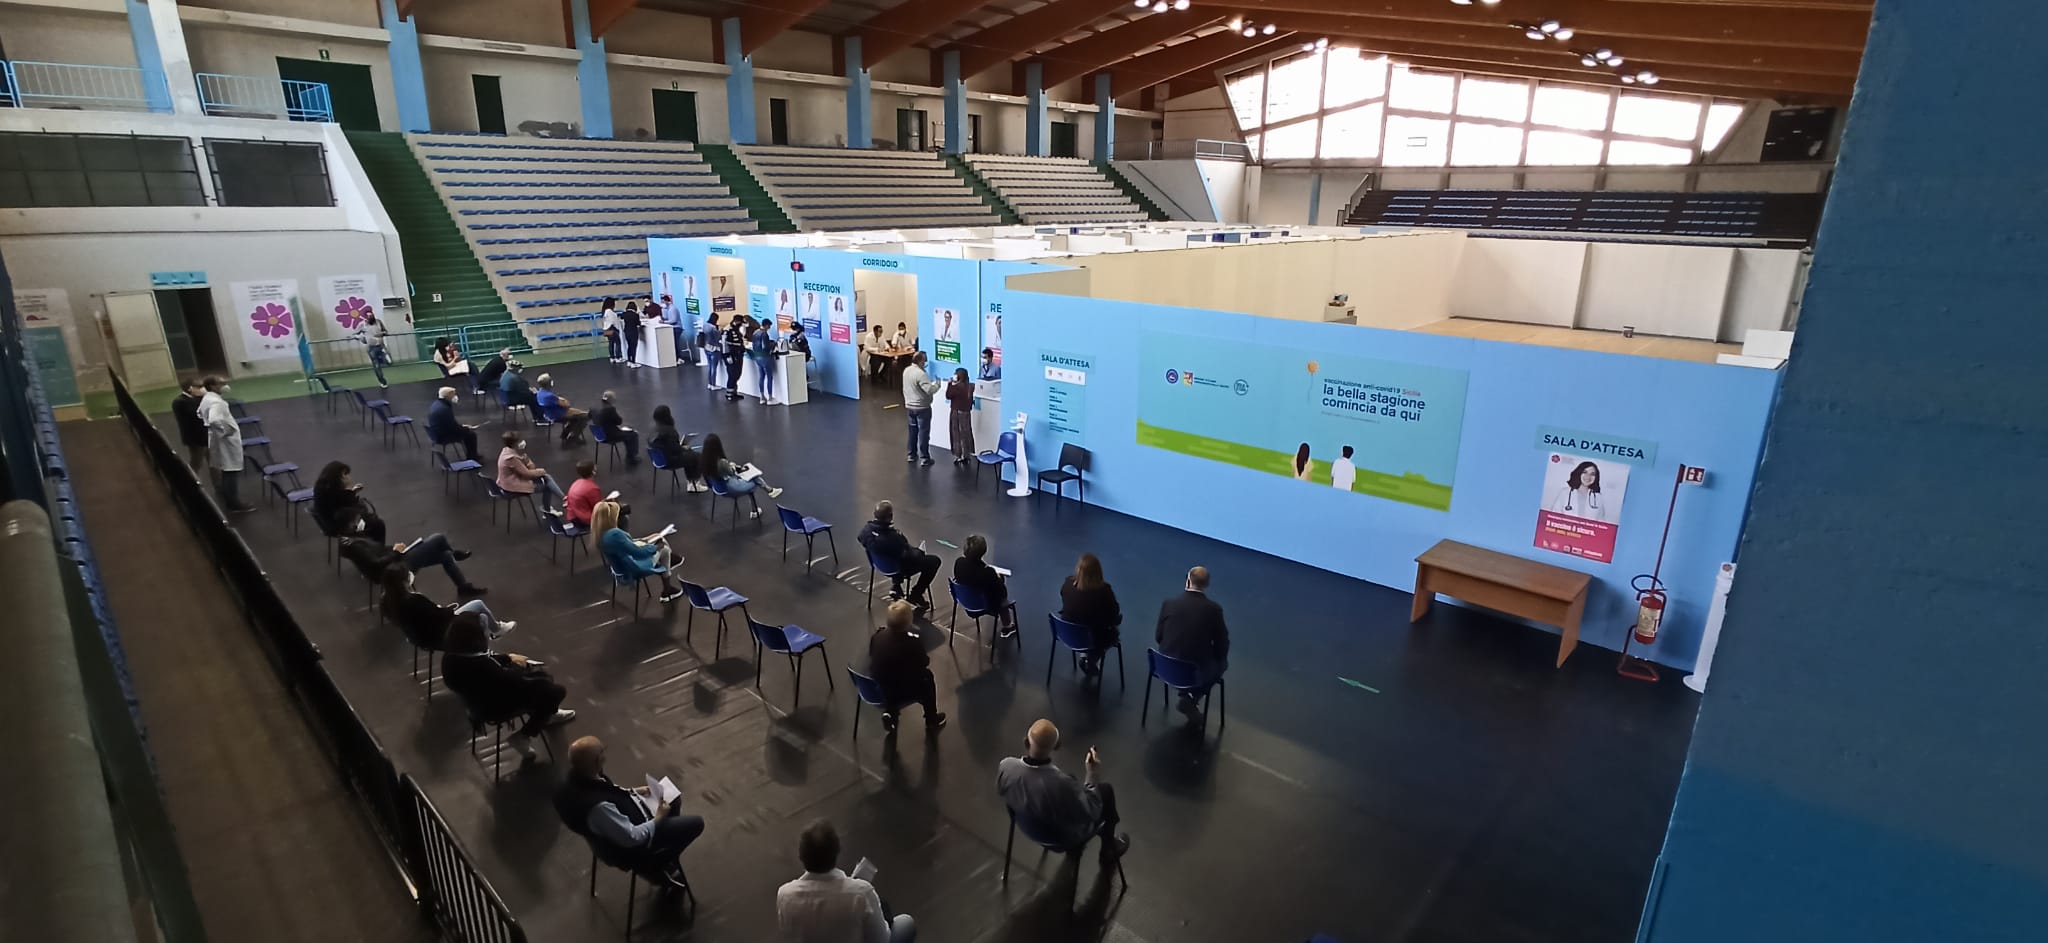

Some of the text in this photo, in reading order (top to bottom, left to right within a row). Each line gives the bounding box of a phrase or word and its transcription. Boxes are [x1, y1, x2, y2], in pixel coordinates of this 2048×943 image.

[862, 258, 898, 268] CORRIDOIO
[803, 282, 841, 294] RECEPTION
[1041, 354, 1090, 368] SALA D'ATTESA
[1323, 384, 1426, 410] la bella stagione
[1322, 397, 1377, 414] comincia
[1381, 405, 1396, 417] da
[1400, 410, 1421, 421] qui
[1543, 434, 1577, 448] SALA
[1580, 440, 1645, 460] D'ATTESA
